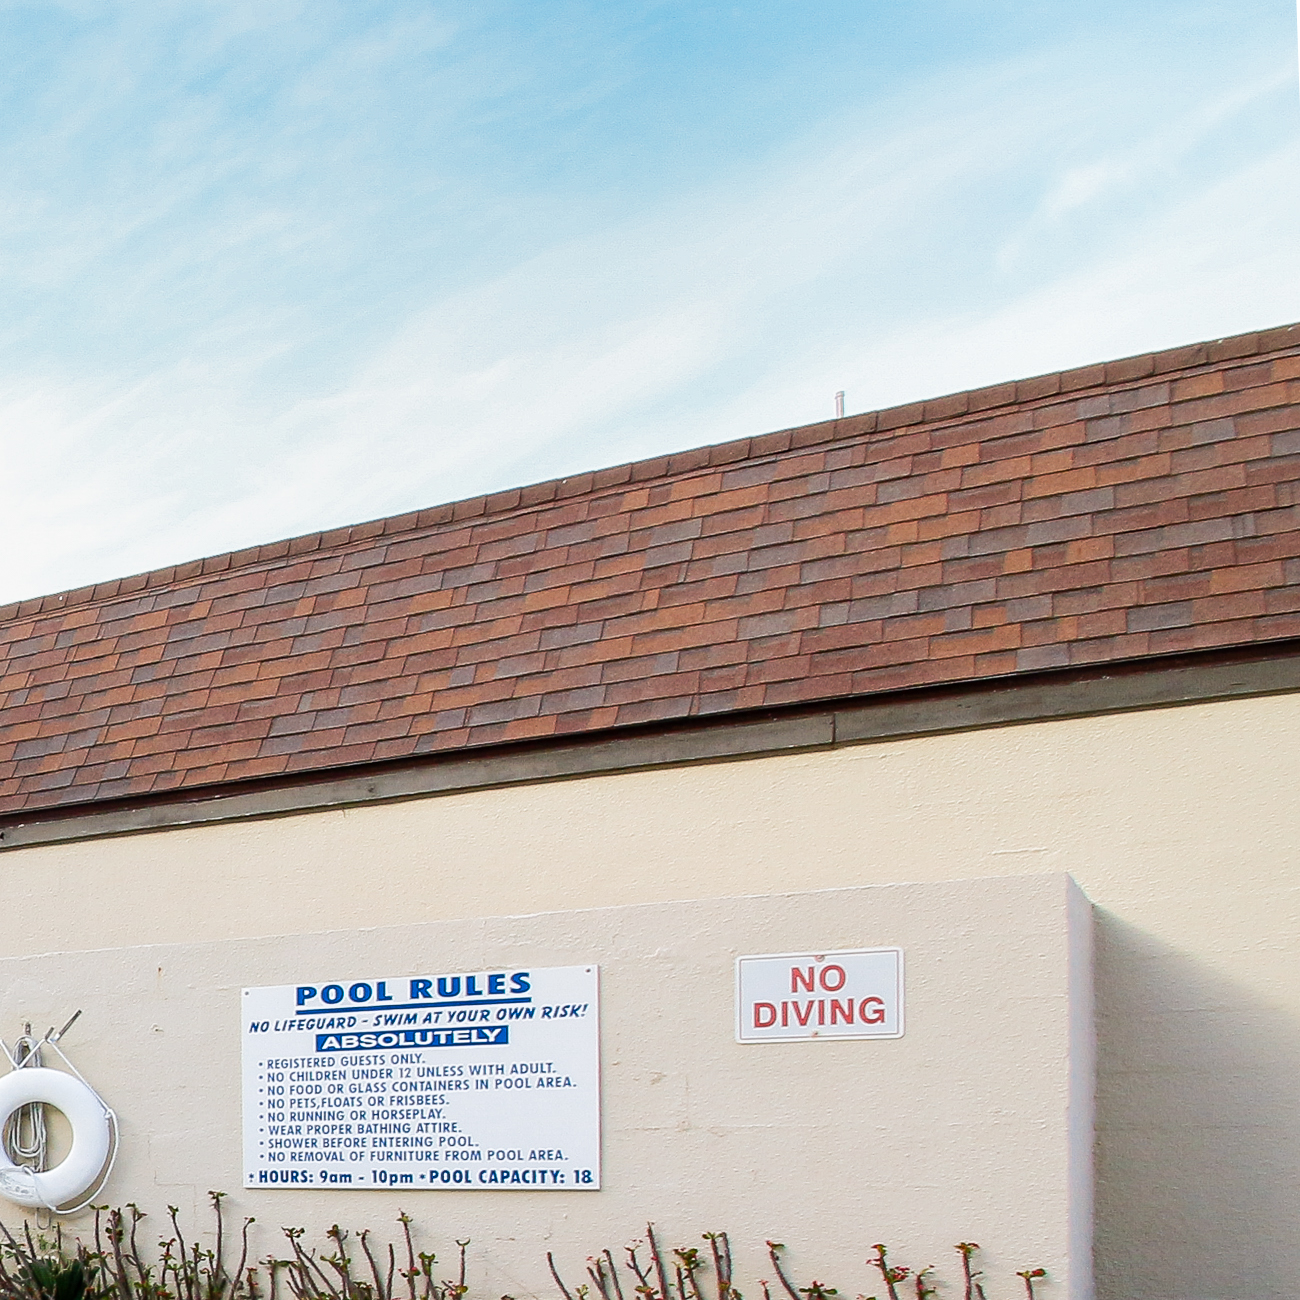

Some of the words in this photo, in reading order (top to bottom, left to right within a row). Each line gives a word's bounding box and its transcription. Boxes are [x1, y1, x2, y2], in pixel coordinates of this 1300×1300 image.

[791, 965, 846, 993] NO
[296, 981, 393, 1006] POOL
[410, 972, 531, 999] RULES
[249, 1021, 270, 1033] NO
[274, 1016, 357, 1032] LIFEGUARD
[373, 1013, 418, 1027] SWIM
[422, 1011, 443, 1025] AT
[449, 1009, 491, 1023] YOUR
[496, 1007, 536, 1021] OWN
[541, 1003, 589, 1019] RISK!
[753, 996, 886, 1029] DIVING
[321, 1028, 502, 1050] ABSOLUTELY
[267, 1056, 336, 1069] REGISTERED
[340, 1054, 386, 1067] GUESTS
[390, 1052, 426, 1065] ONLY.
[267, 1071, 285, 1082] NO
[289, 1069, 347, 1082] CHILDREN
[352, 1068, 393, 1080] UNDER
[399, 1067, 412, 1078] 12
[417, 1065, 464, 1078] UNLESS
[468, 1064, 505, 1076] WITH
[509, 1062, 557, 1074] ADULT.
[267, 1085, 285, 1096] NO
[289, 1084, 323, 1095] FOOD
[327, 1083, 344, 1094] OR
[349, 1082, 387, 1093] GLASS
[391, 1079, 470, 1092] CONTAINERS
[475, 1078, 489, 1090] IN
[495, 1077, 532, 1089] POOL
[536, 1076, 577, 1088] AREA.
[267, 1098, 285, 1109] NO
[368, 1096, 385, 1106] OR
[389, 1094, 450, 1106] FRISBEES.
[267, 1111, 285, 1122] NO
[290, 1110, 345, 1122] RUNNING
[350, 1110, 367, 1121] OR
[371, 1108, 446, 1120] HORSEPLAY.
[268, 1124, 302, 1135] WEAR
[307, 1123, 352, 1135] PROPER
[357, 1122, 411, 1134] BATHING
[416, 1122, 462, 1134] ATTIRE.
[268, 1137, 318, 1149] SHOWER
[322, 1137, 367, 1148] BEFORE
[372, 1136, 433, 1148] ENTERING
[438, 1136, 479, 1147] POOL.
[268, 1151, 286, 1162] NO
[290, 1151, 345, 1162] REMOVAL
[350, 1151, 365, 1162] OF
[370, 1150, 439, 1162] FURNITURE
[445, 1150, 482, 1161] FROM
[487, 1150, 524, 1161] POOL
[528, 1149, 569, 1161] AREA.
[259, 1170, 314, 1183] HOURS:
[319, 1170, 352, 1183] 9am
[371, 1170, 414, 1186] 10pm
[429, 1169, 472, 1184] POOL
[478, 1169, 566, 1184] CAPACITY:
[574, 1169, 594, 1184] 18
